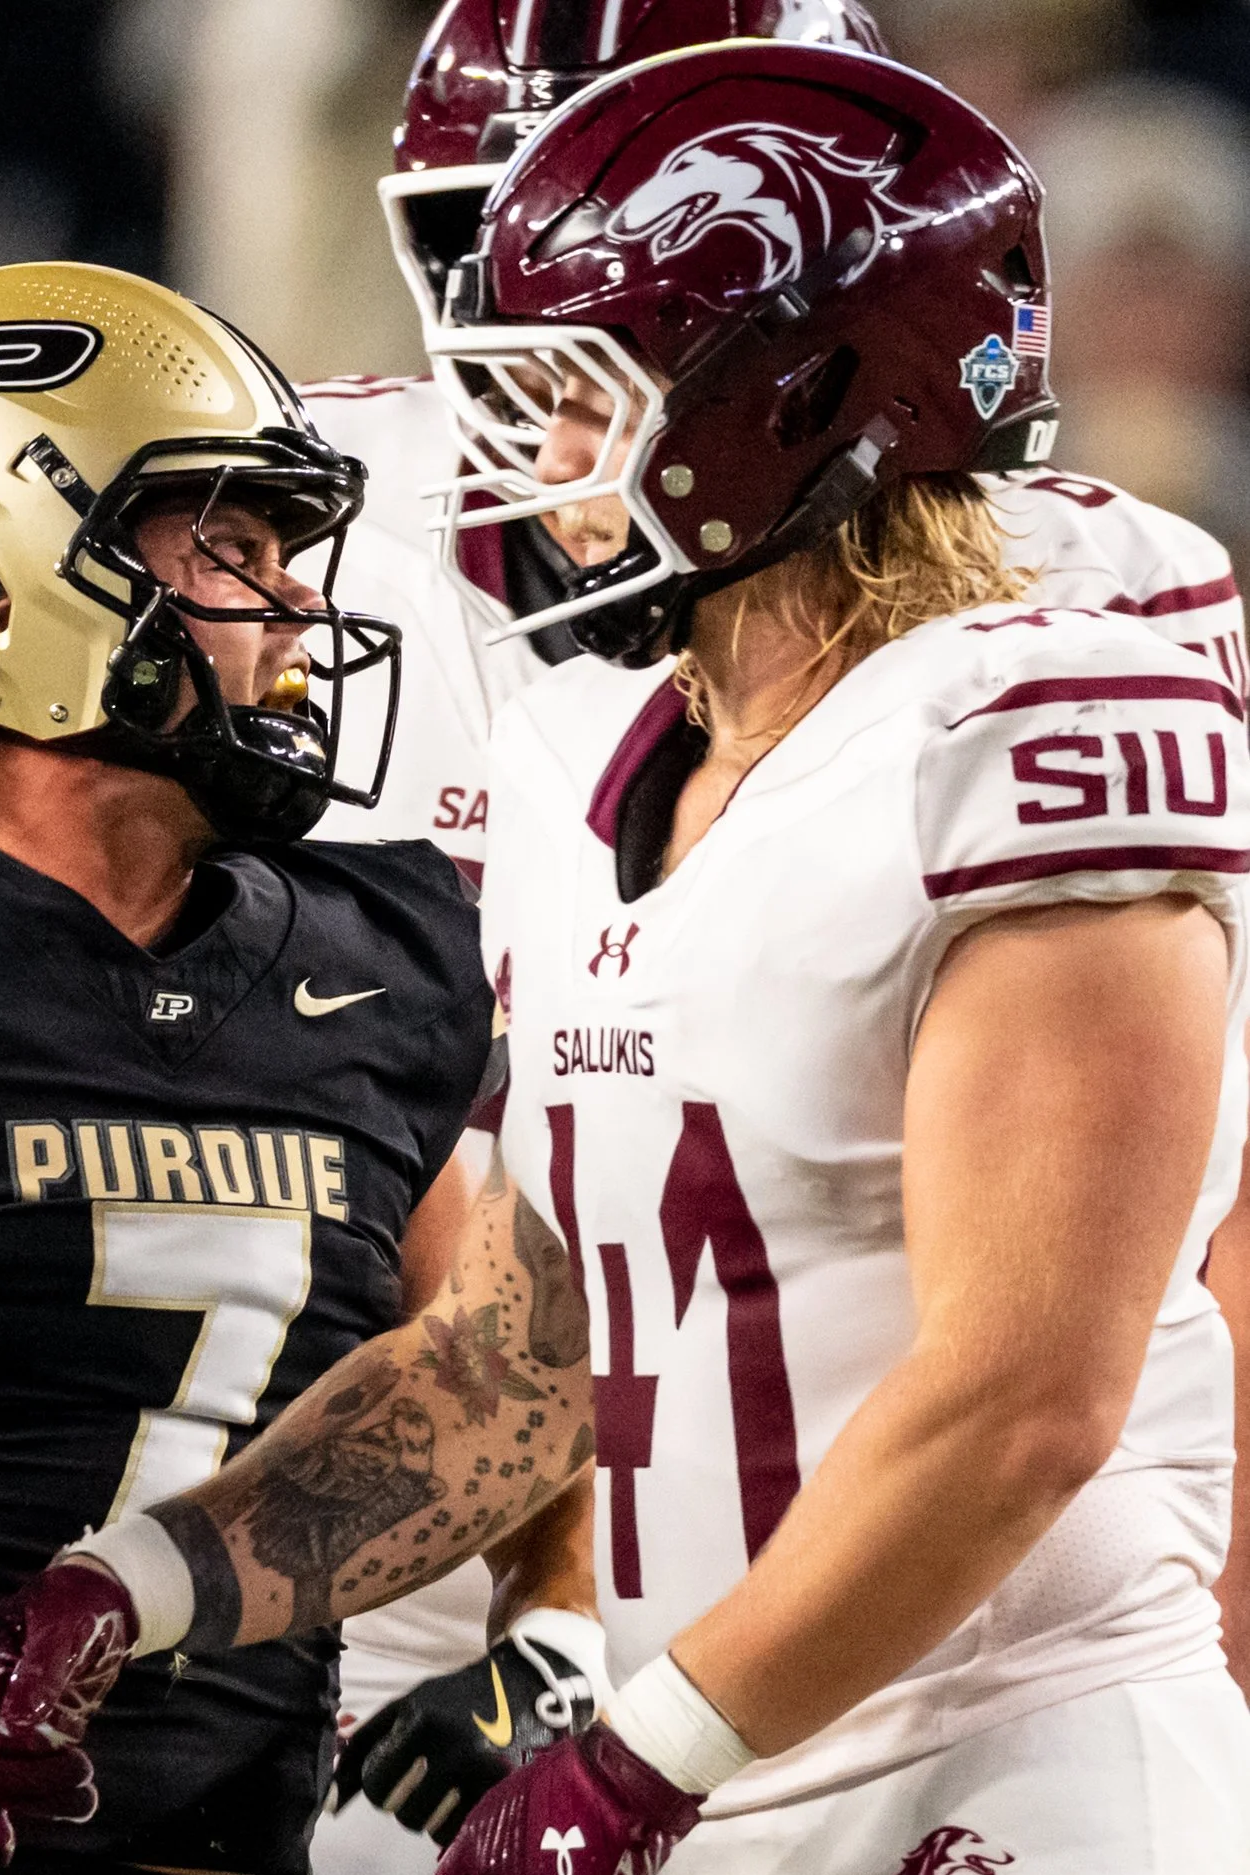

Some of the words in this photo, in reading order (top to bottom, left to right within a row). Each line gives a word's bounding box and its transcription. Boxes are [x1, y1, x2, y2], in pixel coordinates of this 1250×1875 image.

[970, 364, 1011, 380] FCS
[1009, 730, 1228, 825] SIU
[150, 992, 194, 1022] P
[553, 1026, 656, 1078] SALUKIS
[6, 1118, 350, 1224] PURDUE
[86, 1200, 312, 1533] 7
